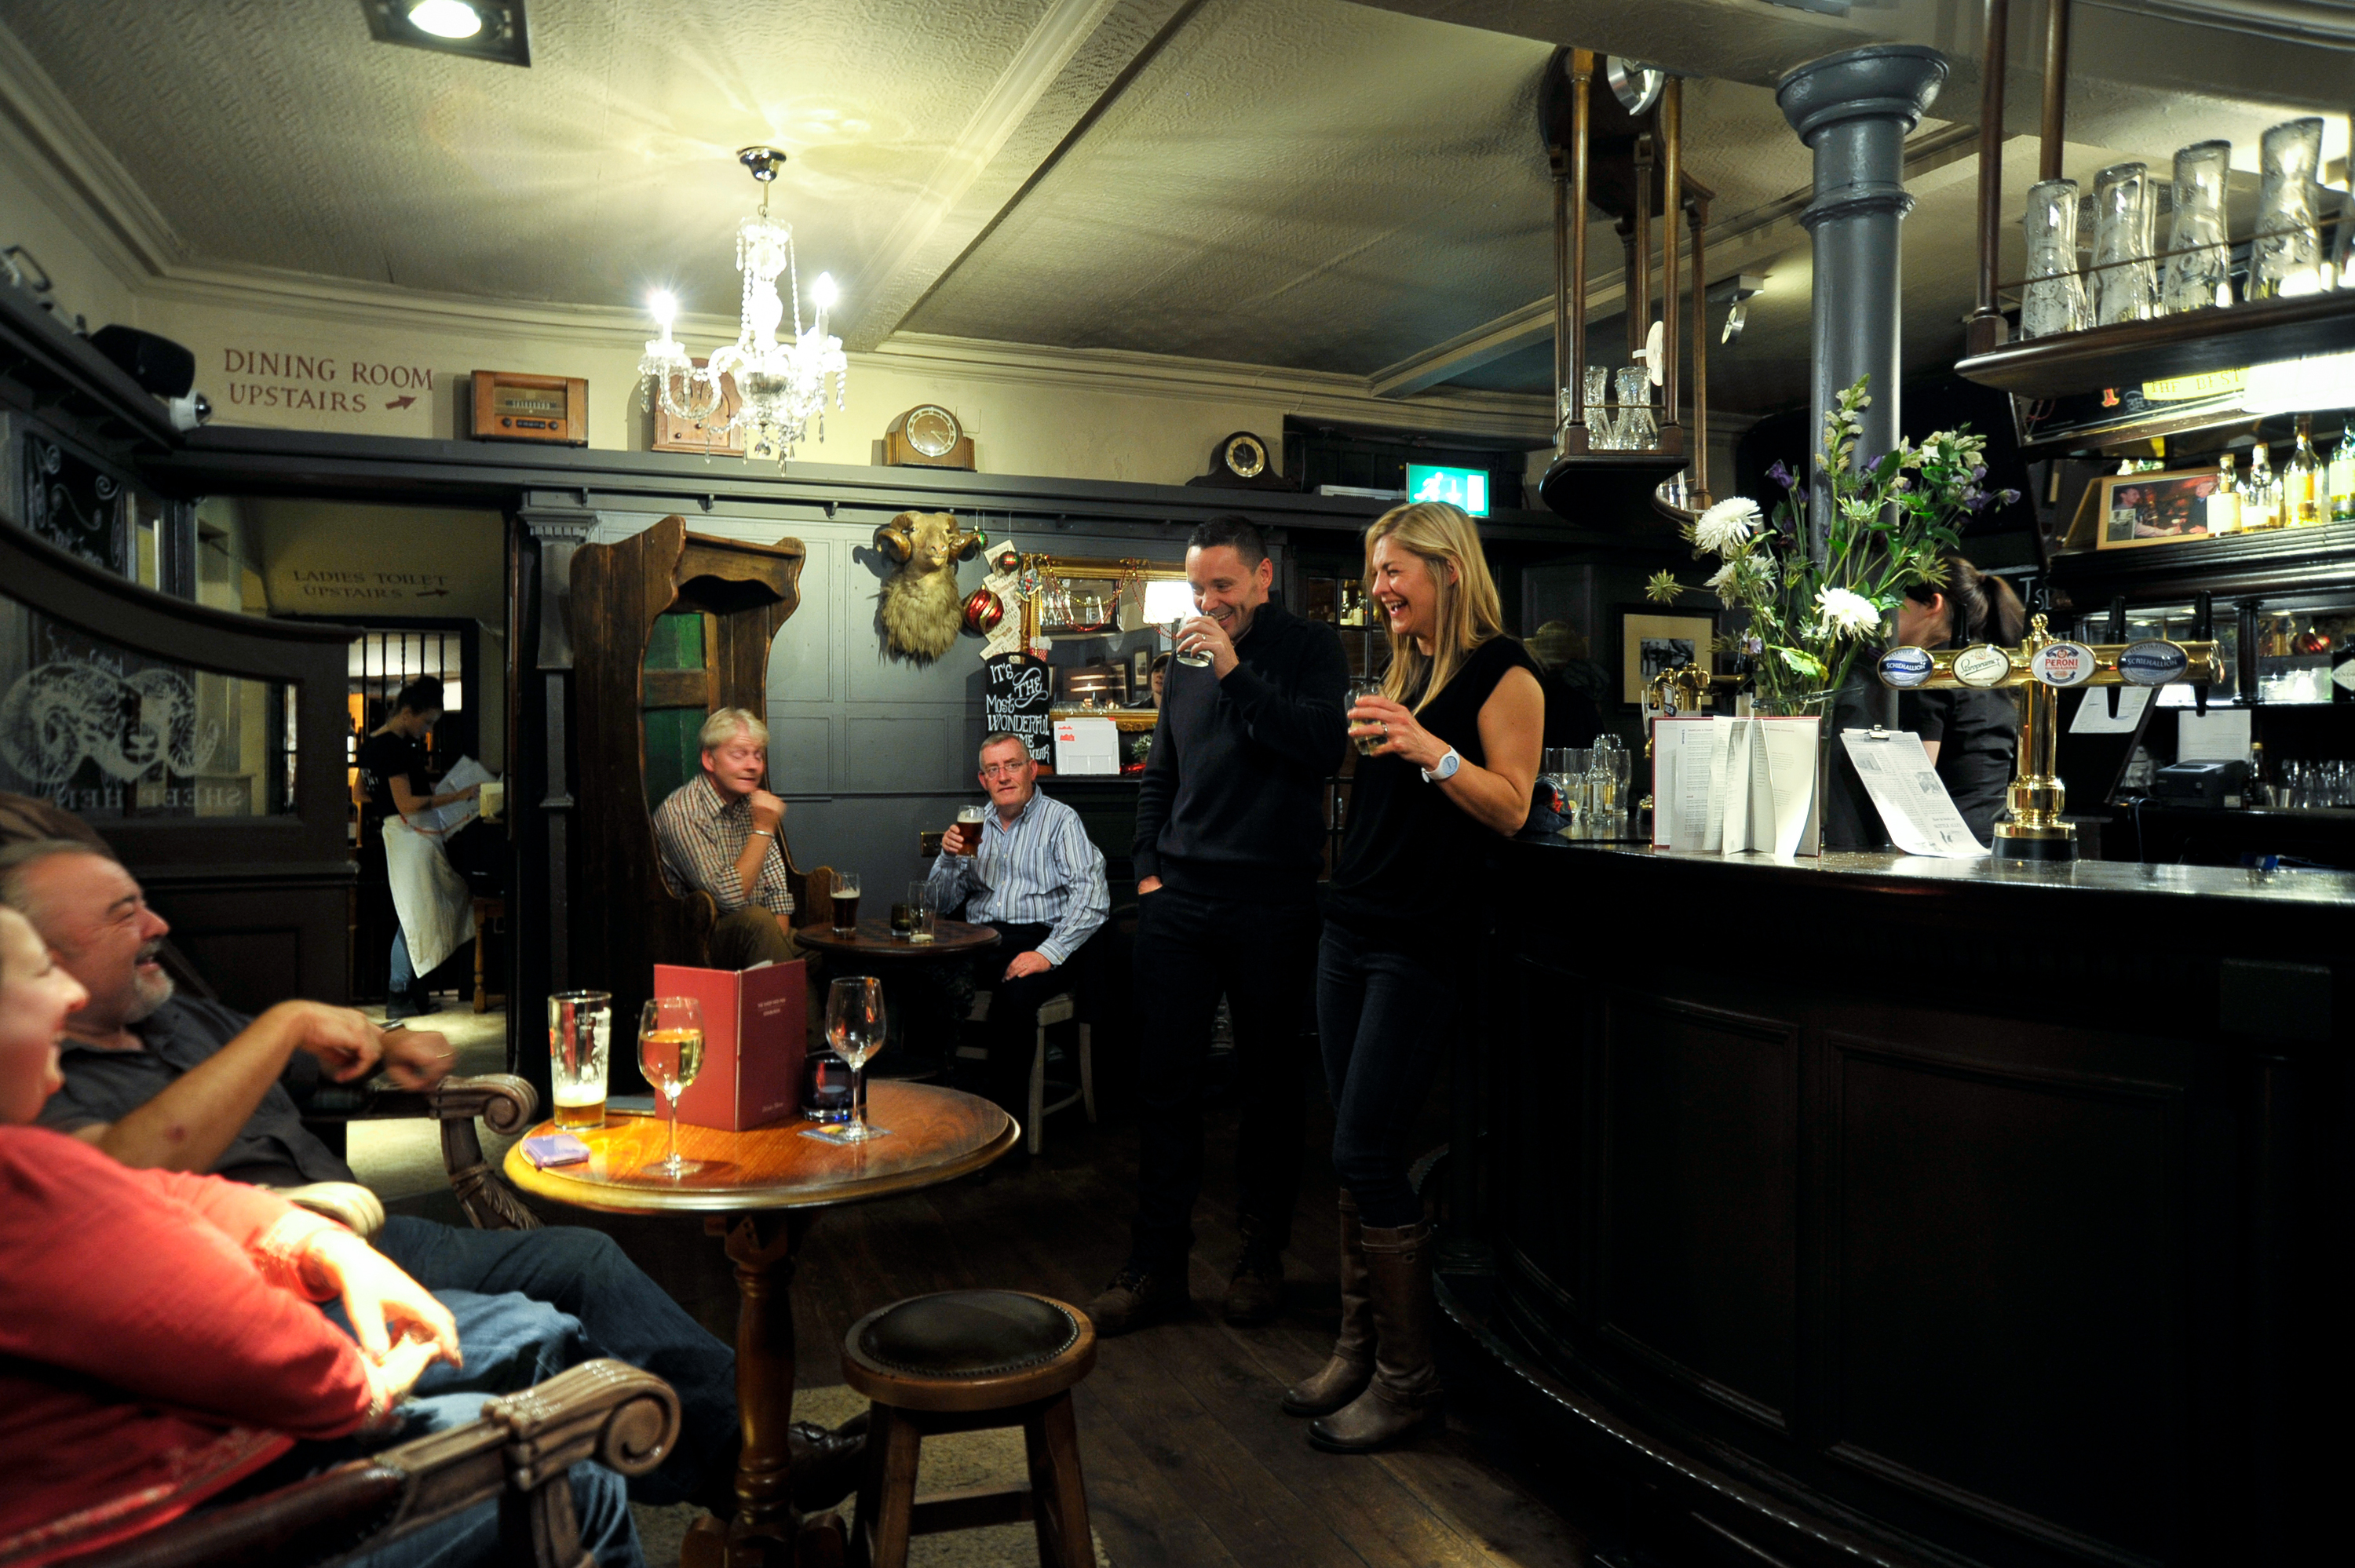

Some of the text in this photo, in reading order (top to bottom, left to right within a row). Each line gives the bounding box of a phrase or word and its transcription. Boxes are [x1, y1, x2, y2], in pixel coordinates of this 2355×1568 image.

[224, 348, 433, 391] DINING ROOM
[2196, 369, 2240, 391] BEST
[229, 382, 367, 413] UPSTAIRS
[293, 571, 448, 586] LADIES TOILET
[302, 584, 403, 599] UPSTAIRS
[1886, 662, 1926, 671] SCHIEHALLION
[2127, 657, 2178, 667] SCHIEHALLION
[990, 662, 1013, 684] IT'S
[1014, 676, 1042, 698] THE
[986, 693, 1014, 714] Most
[987, 714, 1050, 735] WONDERFUL
